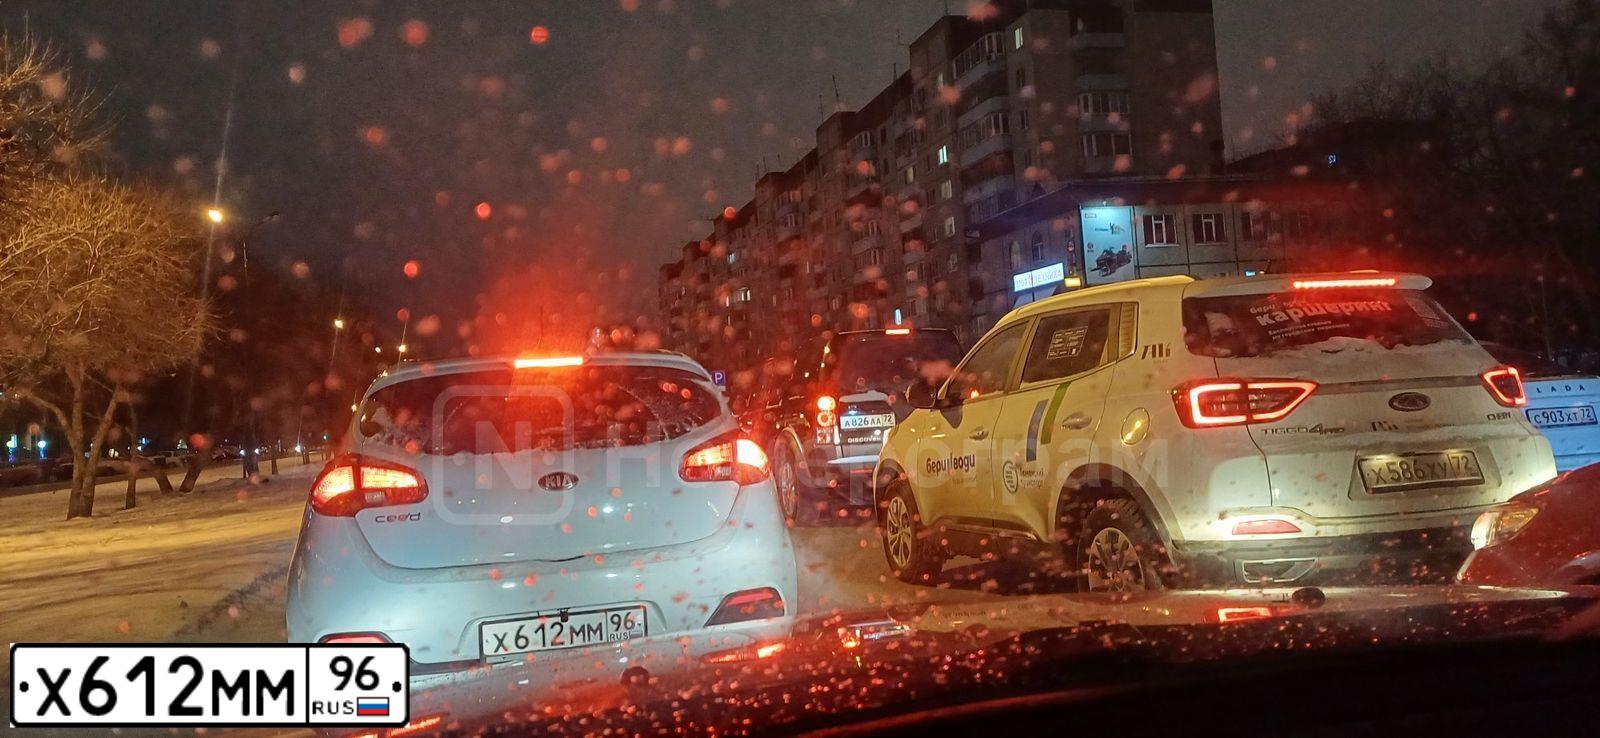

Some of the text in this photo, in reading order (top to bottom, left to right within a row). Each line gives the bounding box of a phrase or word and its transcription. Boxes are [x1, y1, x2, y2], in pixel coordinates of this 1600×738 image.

[714, 372, 723, 384] P
[1536, 384, 1585, 394] LADA
[883, 414, 892, 423] 72
[1534, 408, 1592, 424] С903ХТ 72
[1371, 455, 1473, 485] Х586ХУ 72
[544, 473, 574, 488] KIA
[492, 612, 636, 654] Х612ММ 96
[609, 632, 630, 642] RUS
